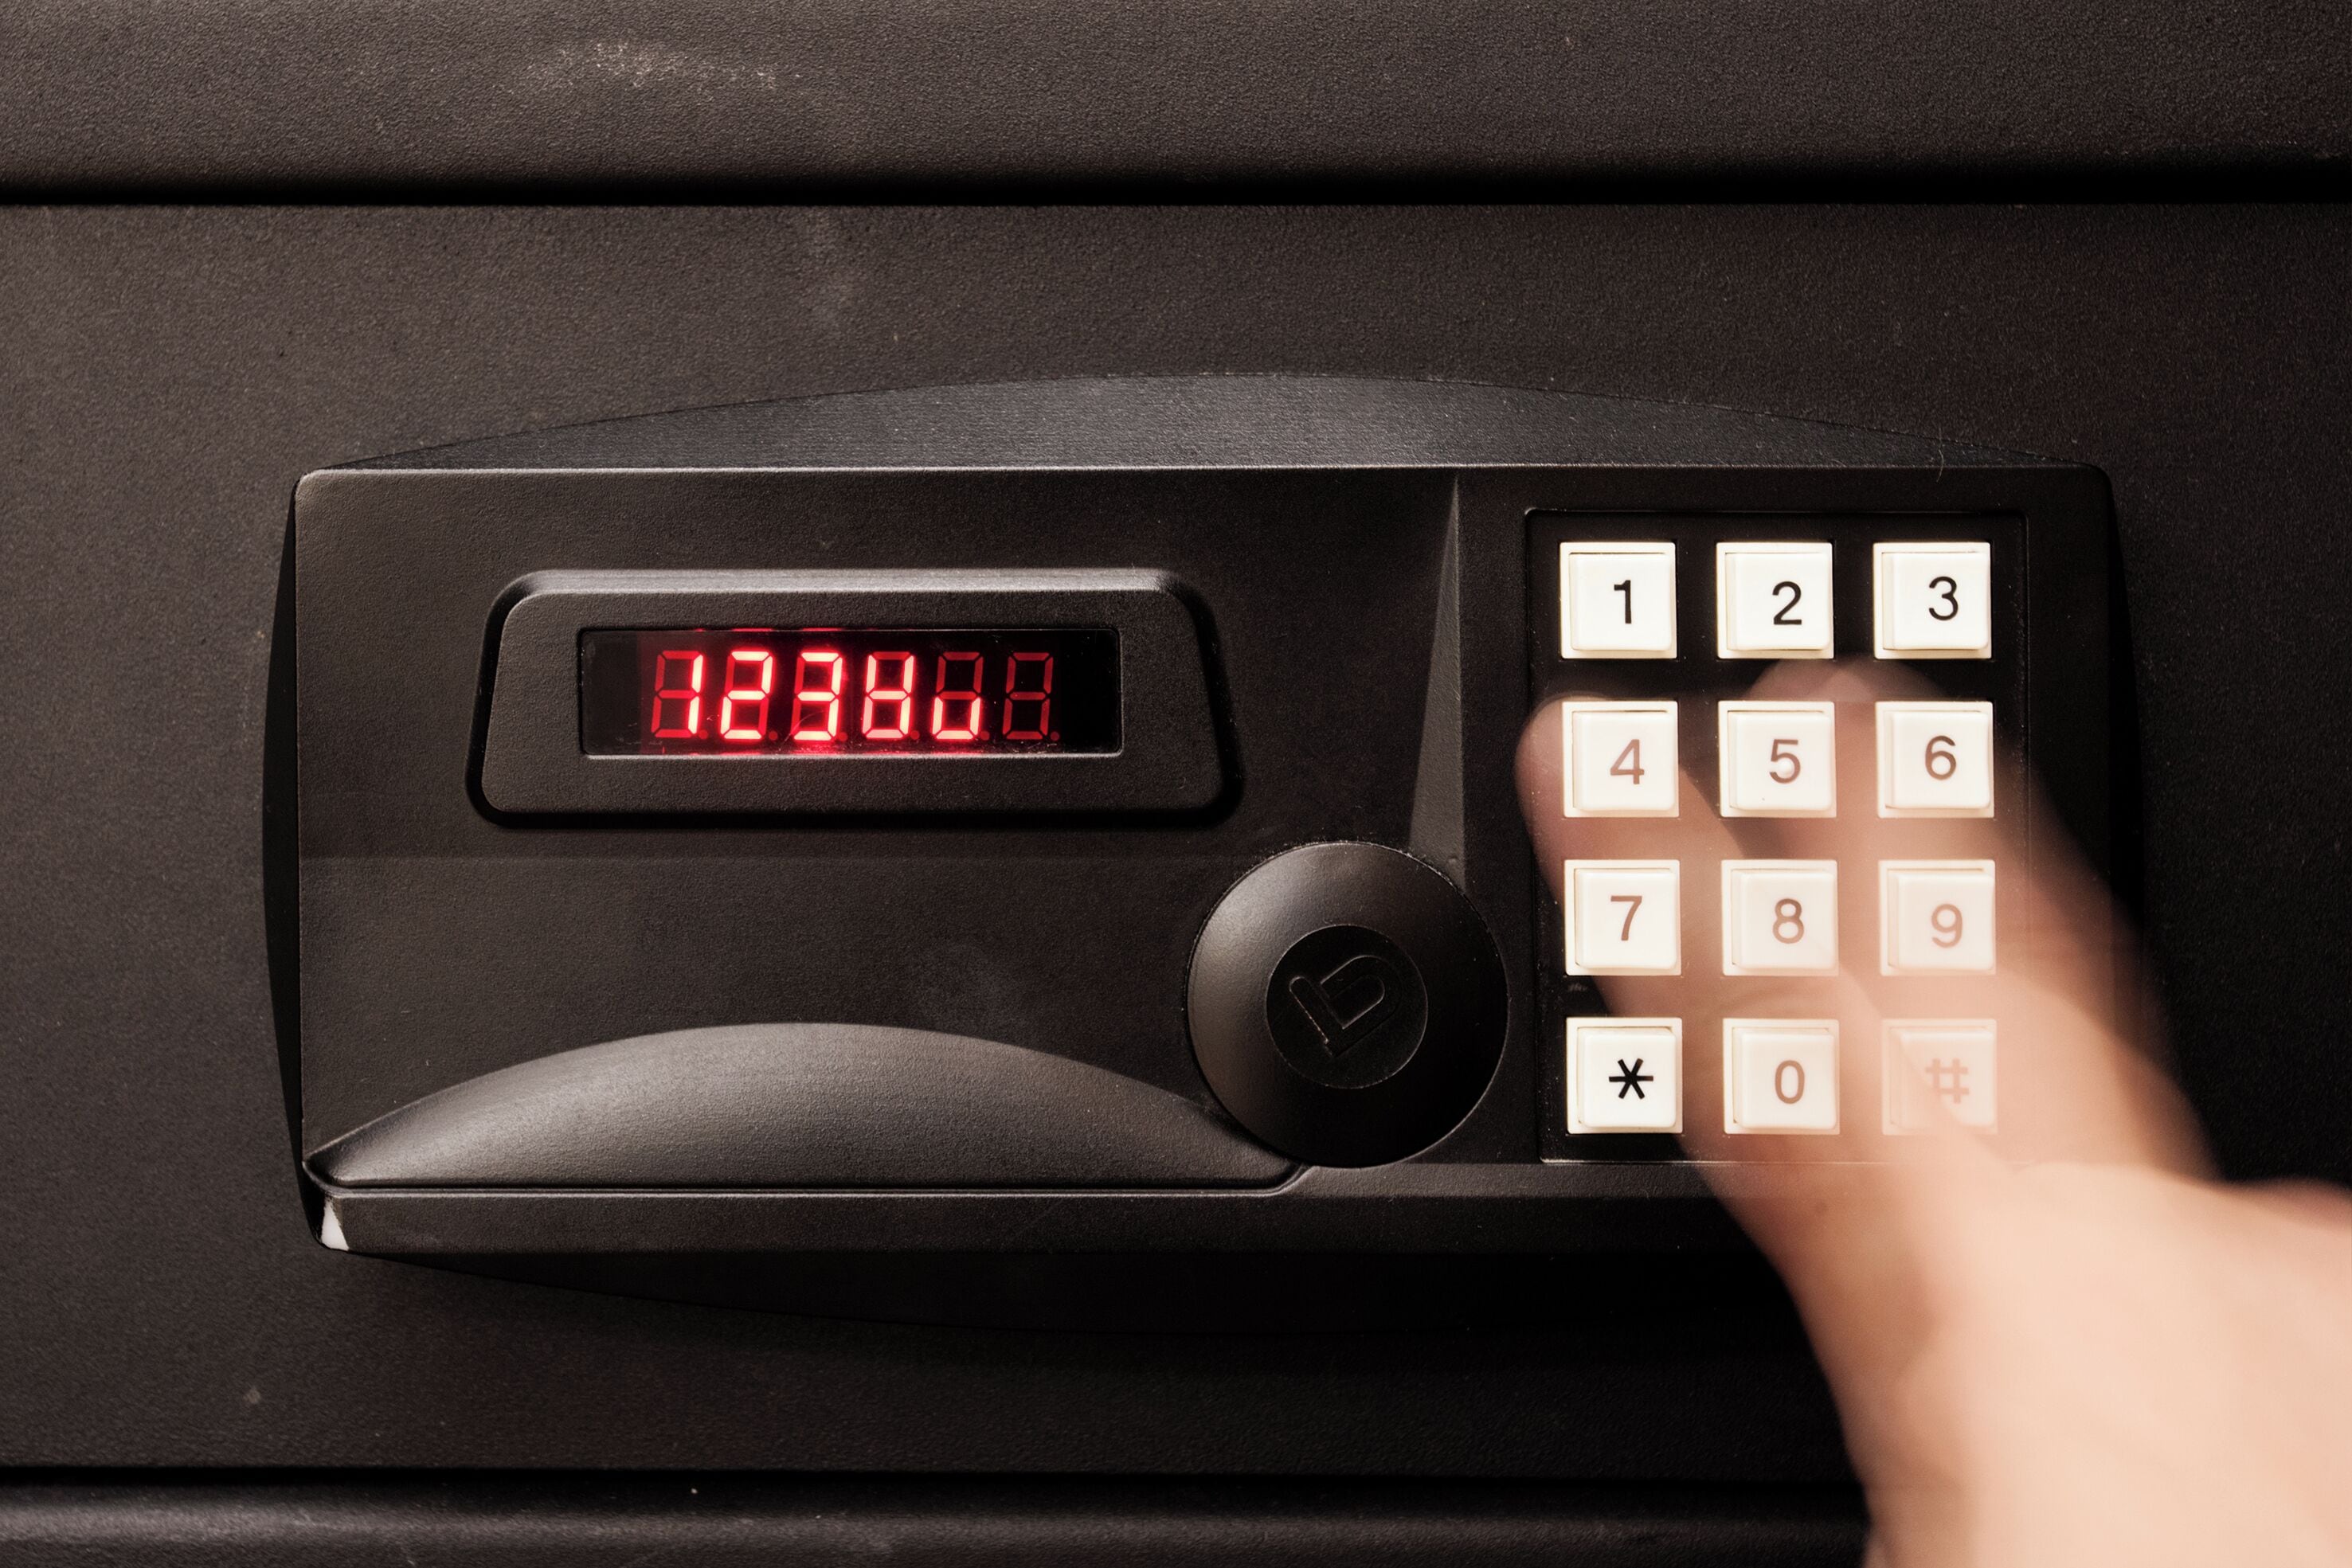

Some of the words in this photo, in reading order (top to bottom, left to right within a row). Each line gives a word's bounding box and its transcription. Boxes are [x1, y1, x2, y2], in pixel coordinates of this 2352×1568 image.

[1613, 579, 1634, 625] 1
[1771, 580, 1803, 627] 2
[1927, 575, 1959, 622] 3
[1609, 738, 1646, 786] 4
[1769, 738, 1802, 785] 5
[1924, 734, 1958, 781] 6
[1610, 894, 1643, 942] 7
[1772, 897, 1806, 944] 8
[1931, 903, 1963, 948] 9
[1774, 1059, 1806, 1105] 0
[1924, 1057, 1970, 1105] #
